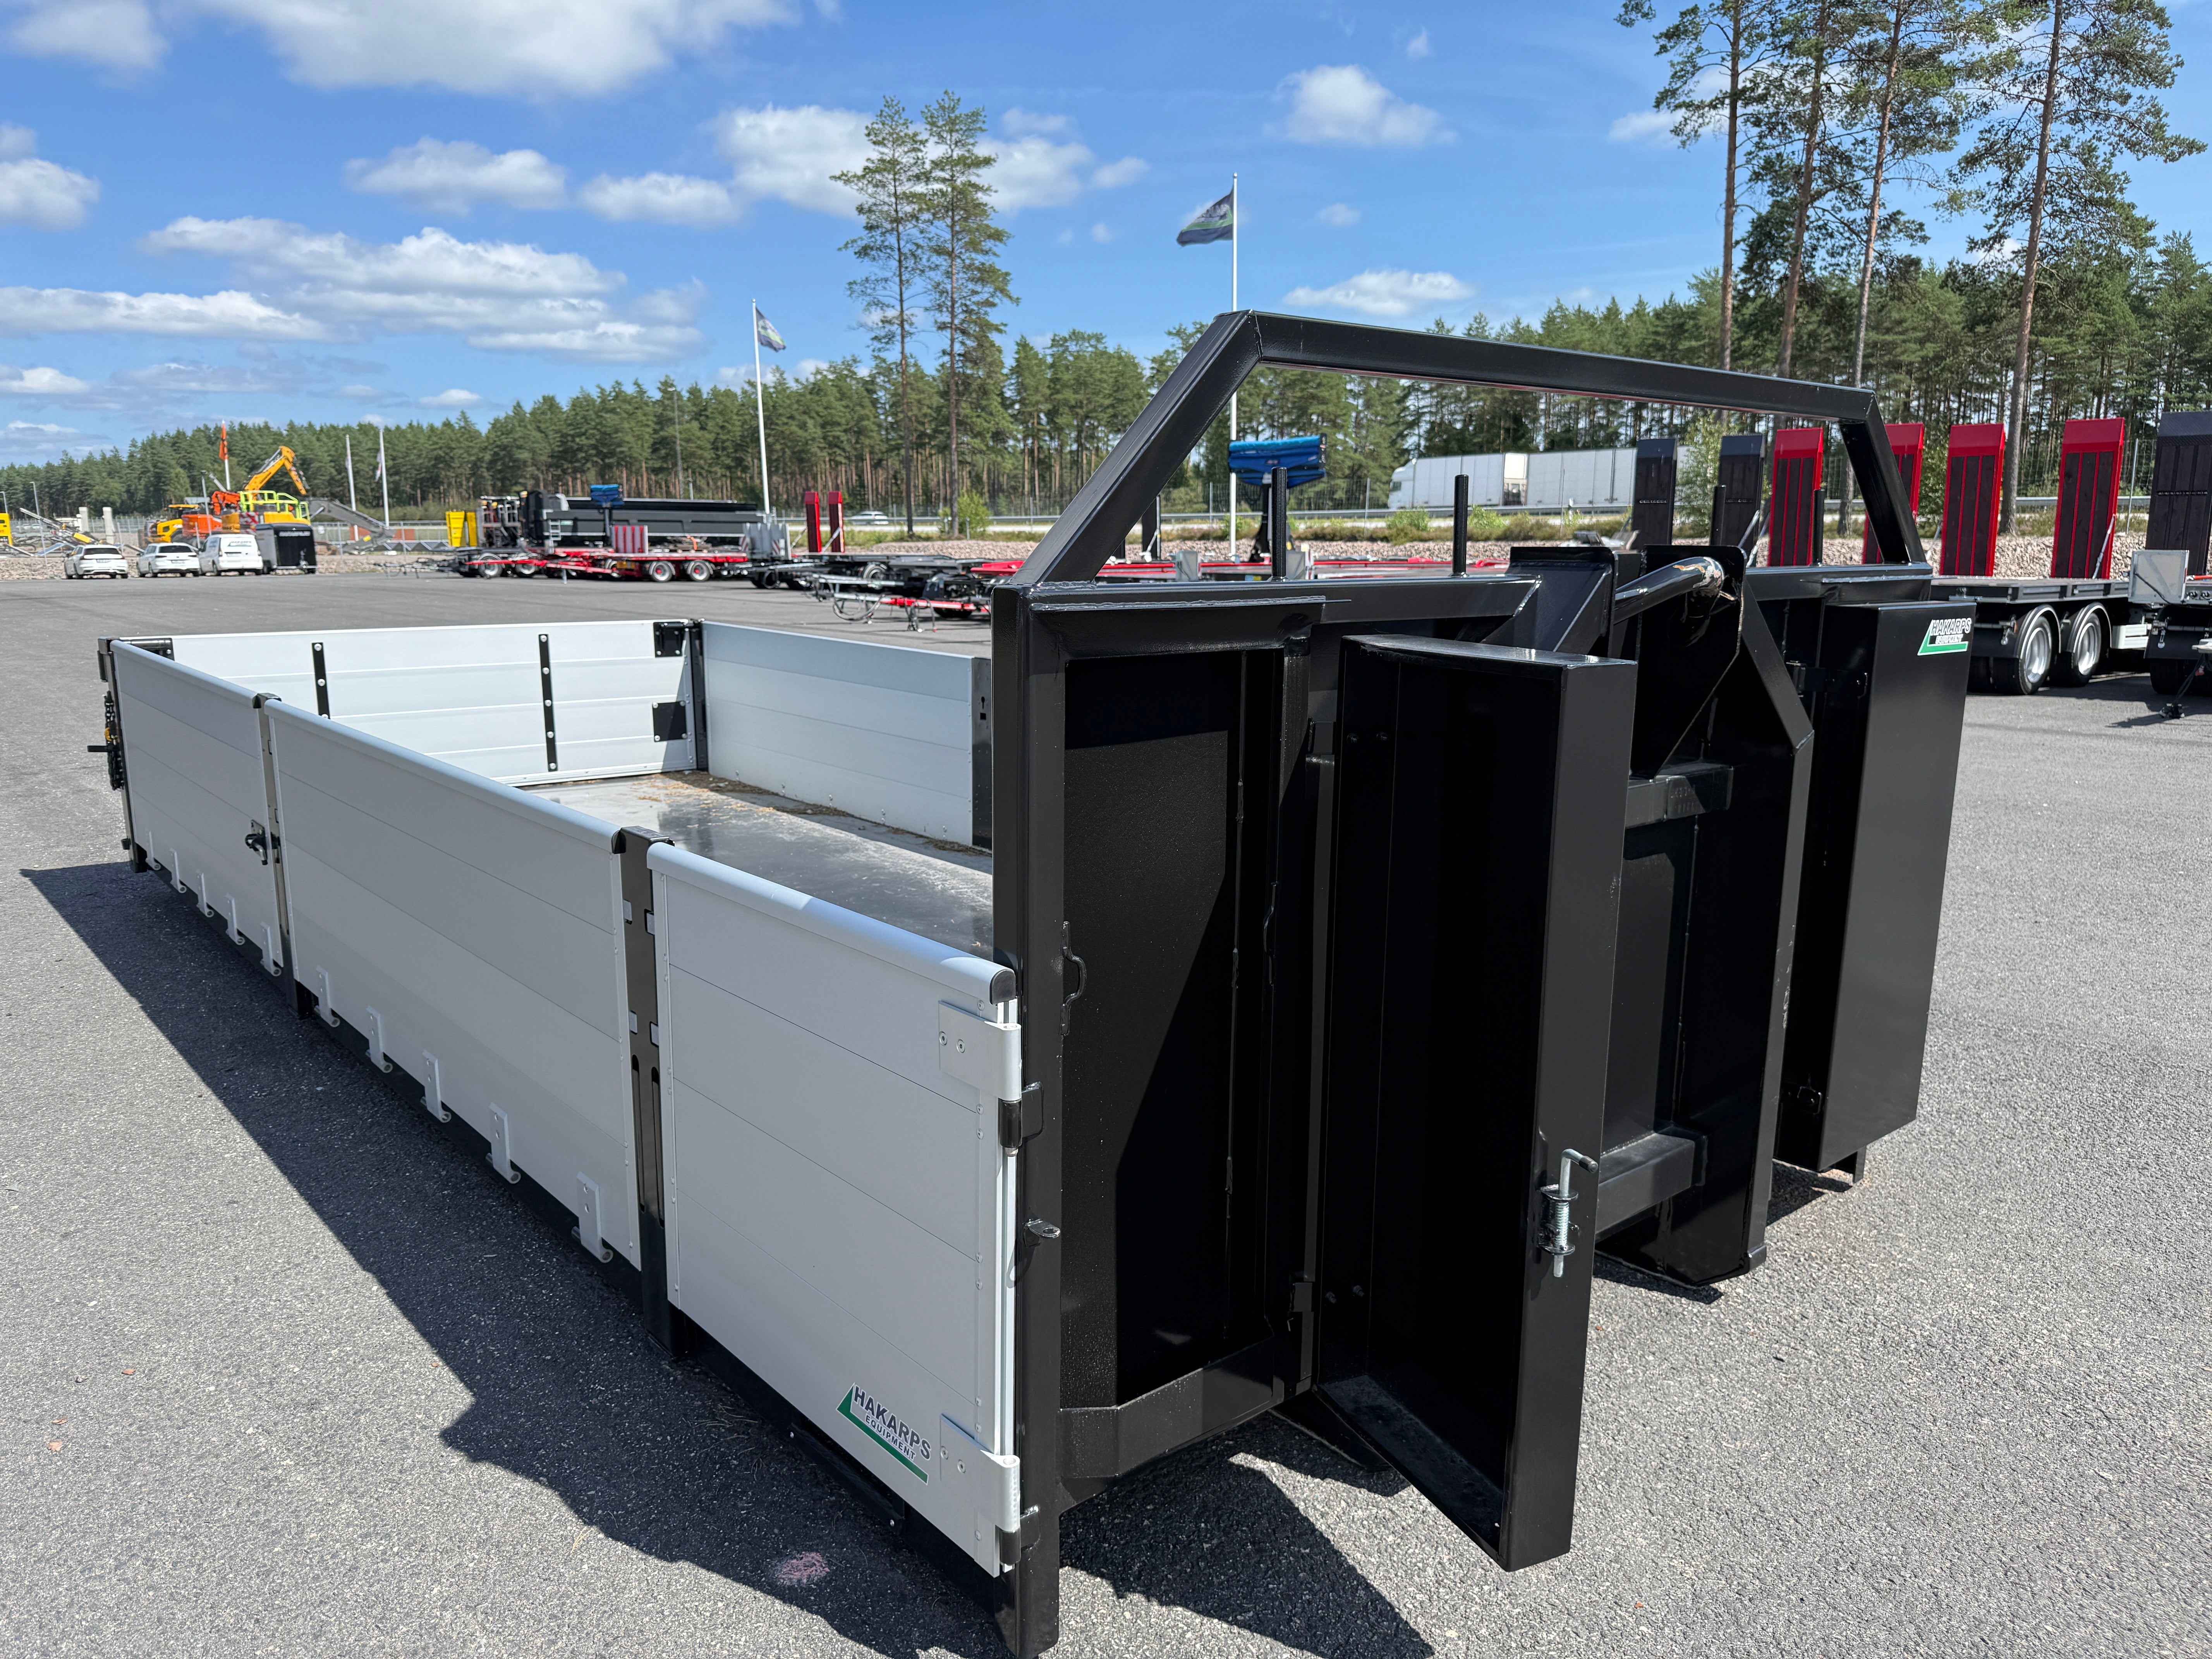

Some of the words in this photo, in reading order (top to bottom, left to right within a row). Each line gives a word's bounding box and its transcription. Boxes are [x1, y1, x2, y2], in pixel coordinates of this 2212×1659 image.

[1930, 618, 1972, 635] HAKARPS
[854, 1385, 931, 1460] HAKARPS
[865, 1414, 916, 1460] EQUIPMENT
